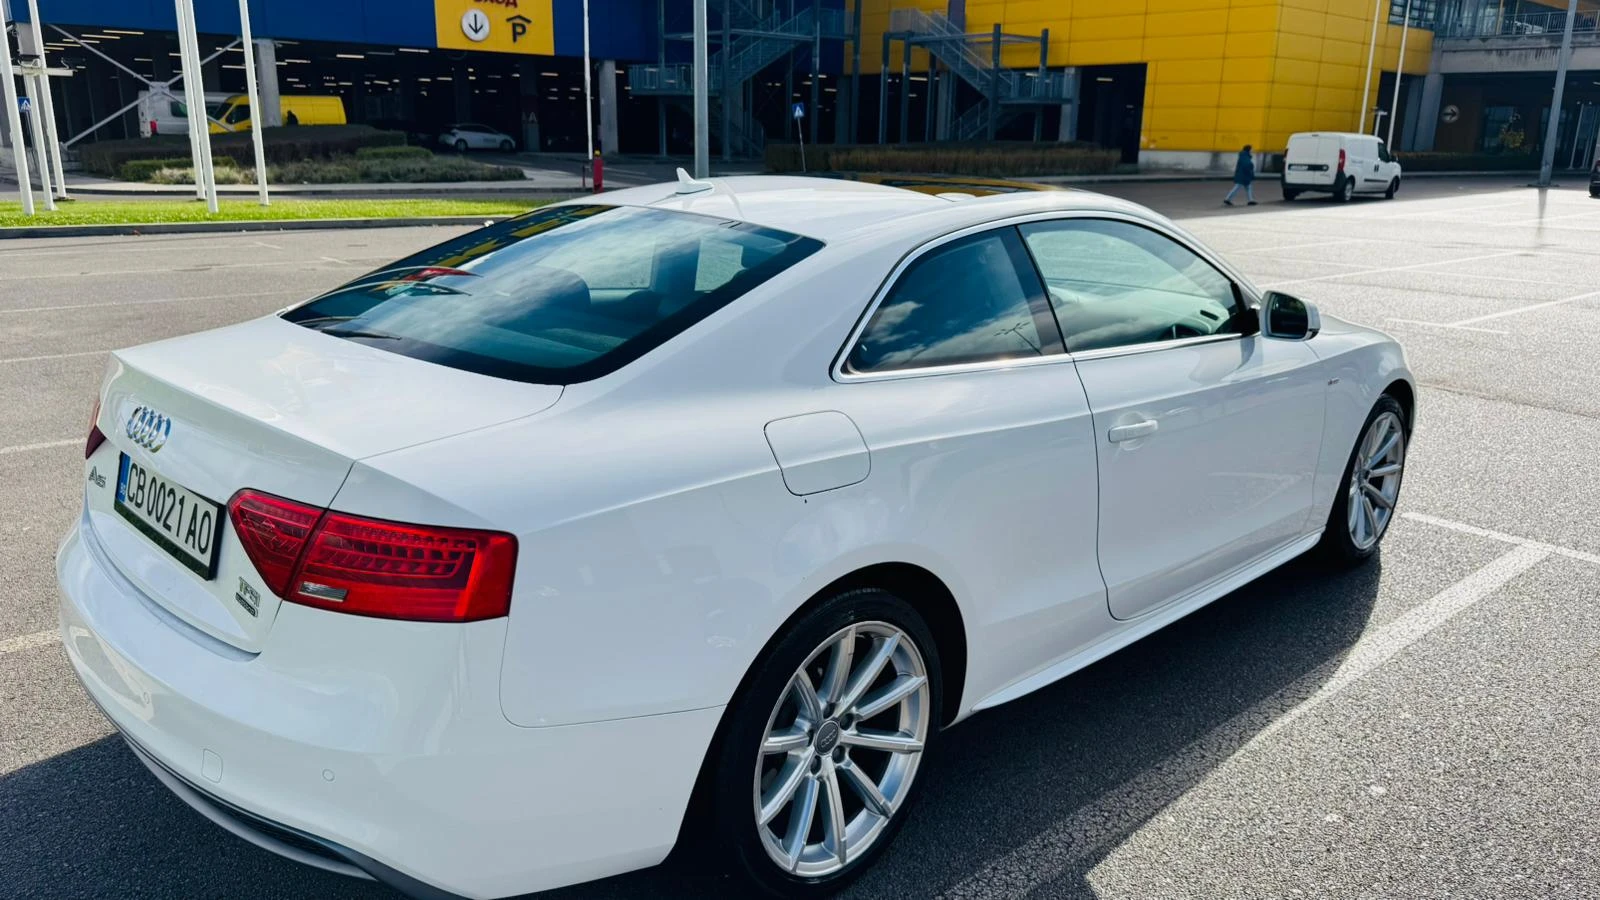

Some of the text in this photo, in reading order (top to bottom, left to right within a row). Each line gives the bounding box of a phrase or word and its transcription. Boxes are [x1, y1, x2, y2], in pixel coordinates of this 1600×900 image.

[511, 22, 527, 43] P
[88, 465, 107, 489] A5
[128, 462, 212, 555] CB 0021 AO
